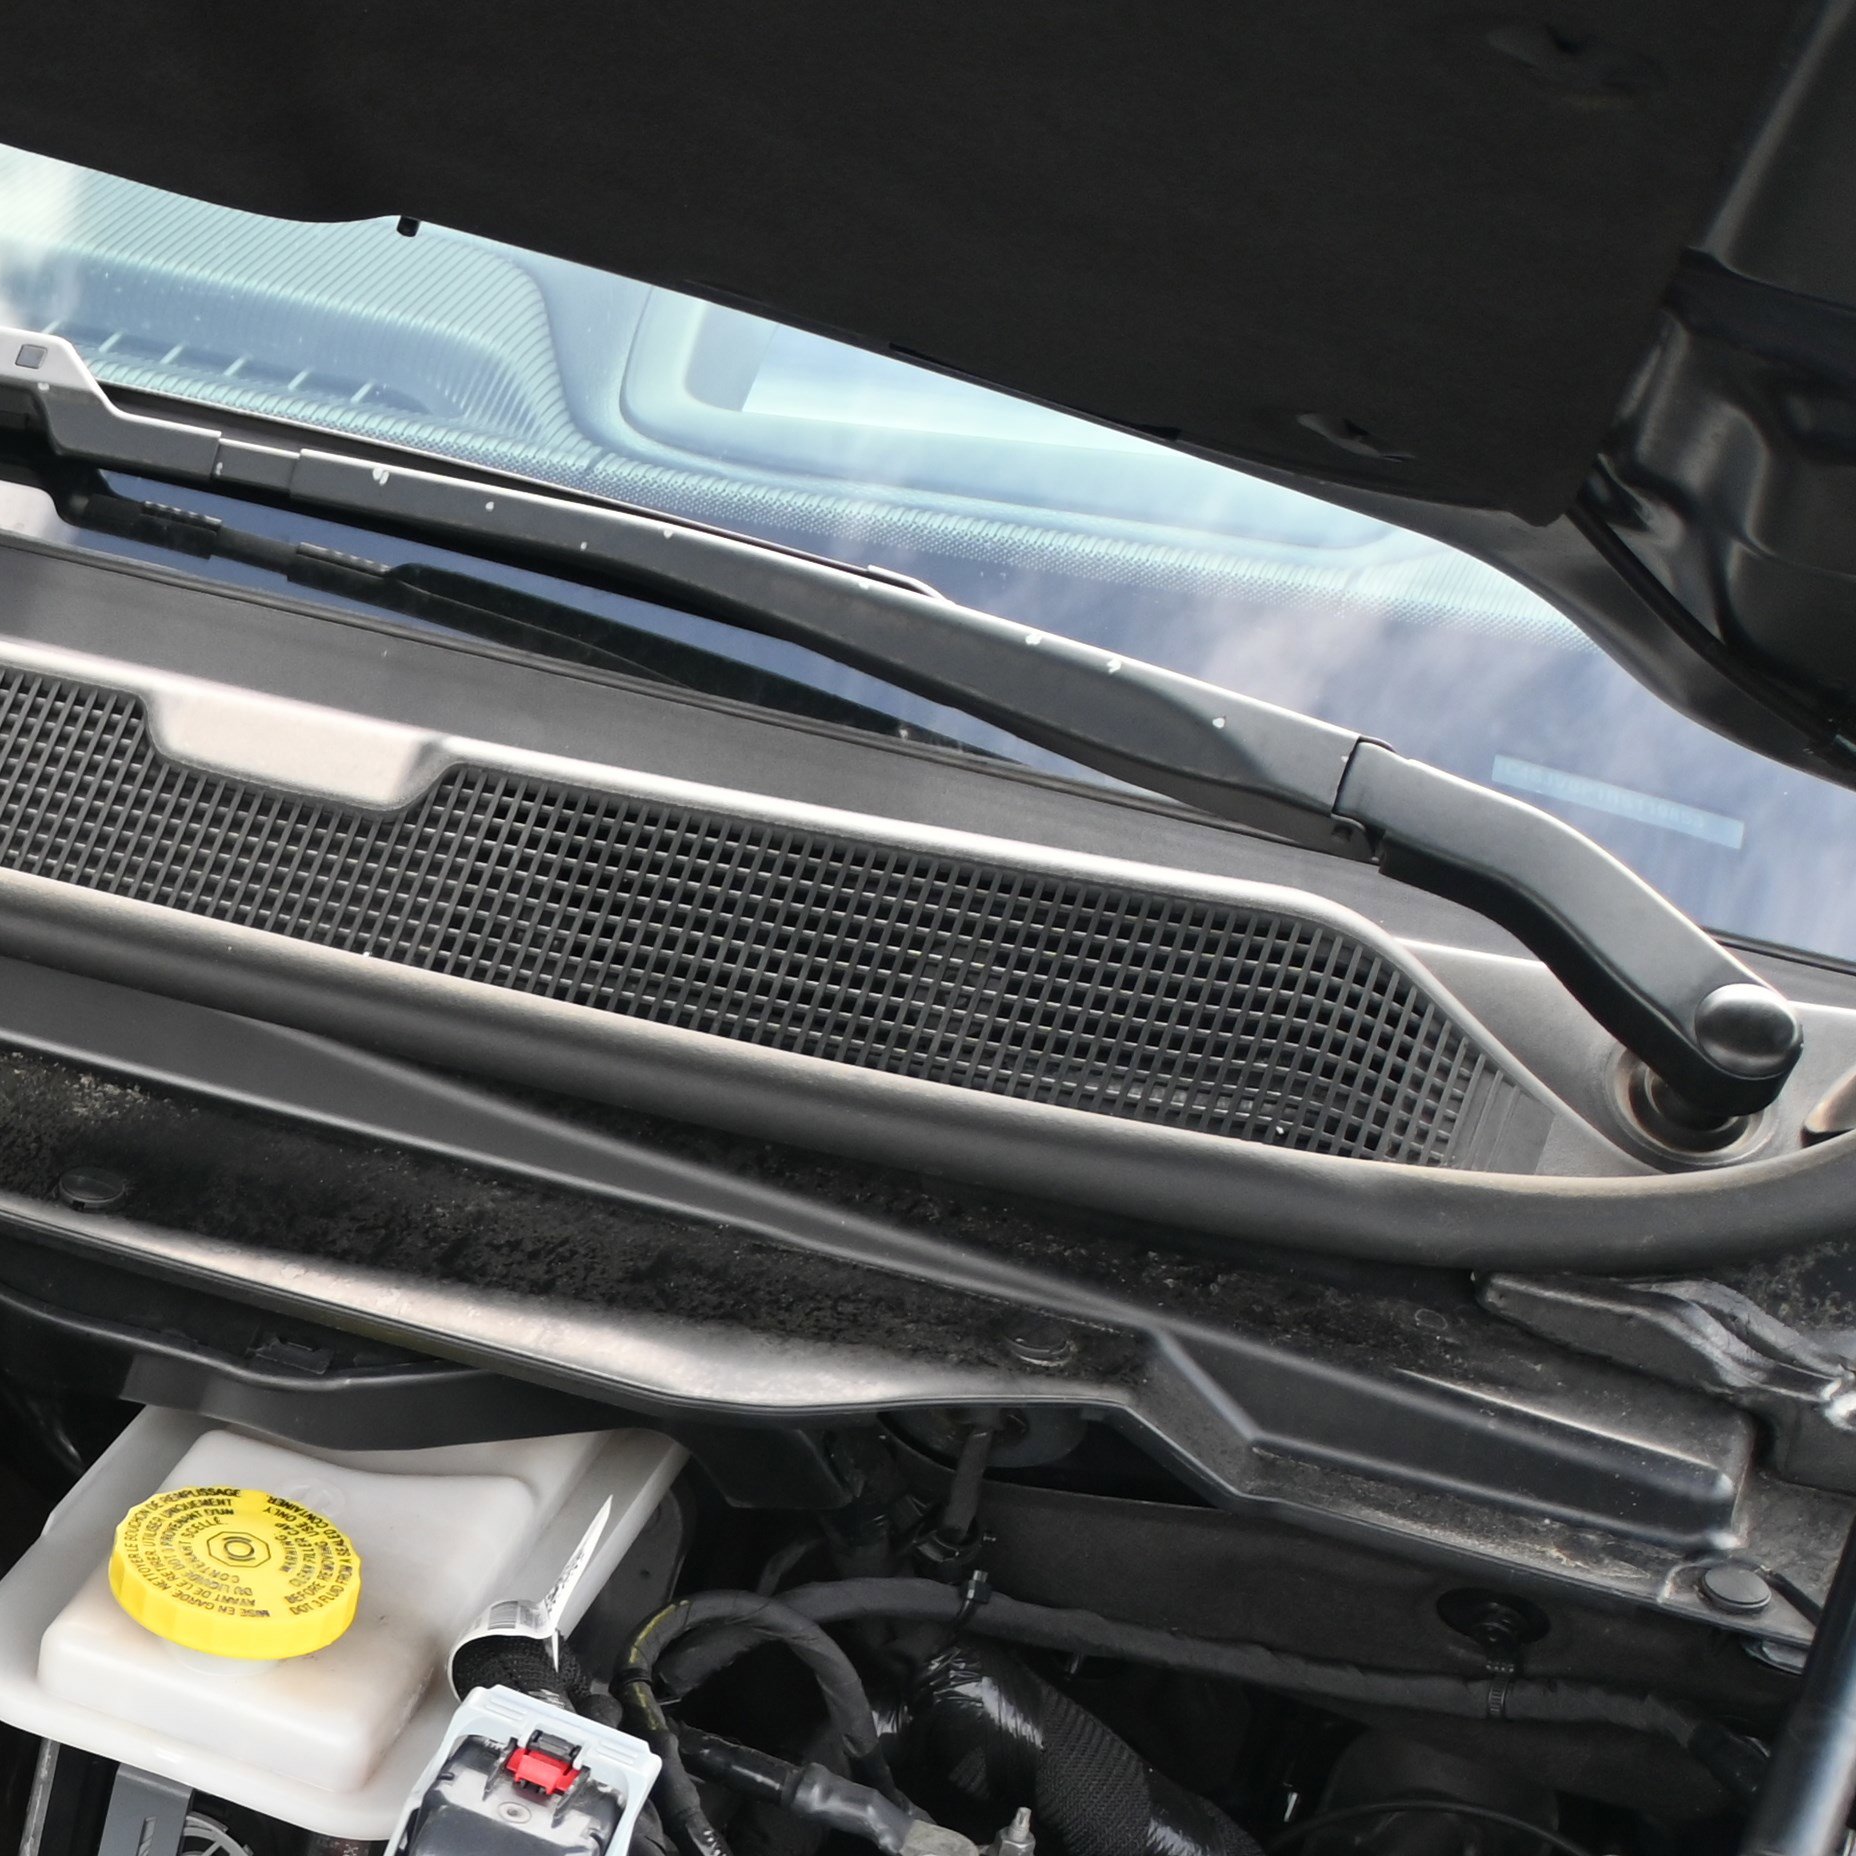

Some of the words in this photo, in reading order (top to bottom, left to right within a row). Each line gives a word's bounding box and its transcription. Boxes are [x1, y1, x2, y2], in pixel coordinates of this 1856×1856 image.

[160, 1487, 241, 1503] REMPLISSAGE
[146, 1501, 163, 1511] DE
[160, 1498, 232, 1518] UNIQUEMENT
[263, 1506, 297, 1522] ONLY
[124, 1505, 150, 1541] BOUCHON
[160, 1510, 203, 1546] PROVENANT
[274, 1522, 300, 1536] CAP
[294, 1521, 320, 1537] USE
[142, 1516, 163, 1547] UTILISER
[124, 1543, 138, 1552] LE
[294, 1537, 316, 1563] FILLER
[323, 1528, 352, 1557] SEALED
[164, 1555, 185, 1570] DOT
[128, 1553, 172, 1591] NETTOYER
[335, 1564, 353, 1585] FROM
[177, 1580, 193, 1591] LE
[193, 1588, 212, 1599] DE
[284, 1581, 326, 1603] BEFORE
[318, 1584, 344, 1603] FLUID
[215, 1594, 256, 1606] AVANT
[218, 1605, 235, 1616] EN
[289, 1603, 314, 1615] DOT
